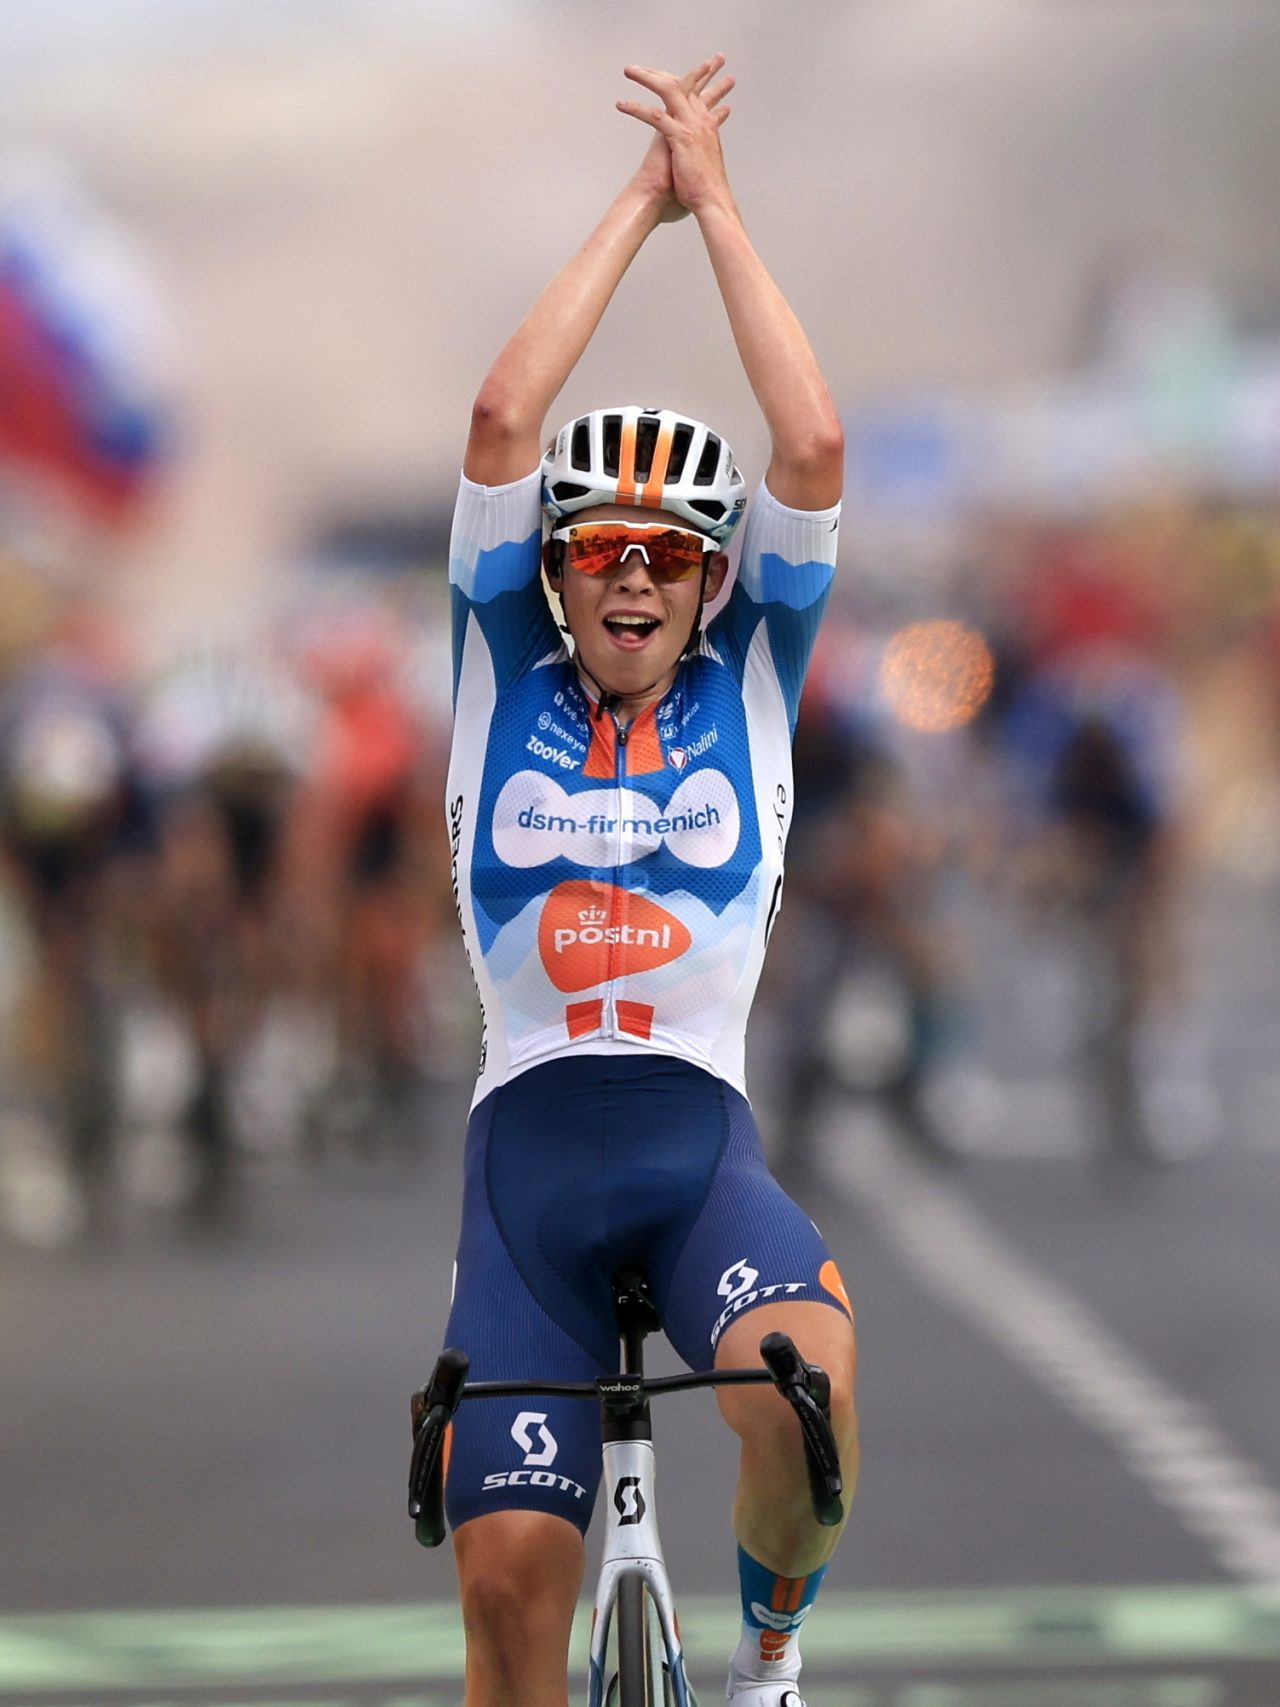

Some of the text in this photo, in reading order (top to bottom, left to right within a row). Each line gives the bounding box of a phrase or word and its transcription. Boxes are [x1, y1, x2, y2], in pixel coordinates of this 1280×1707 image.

[526, 735, 581, 771] zoover
[549, 721, 588, 753] nexeye
[686, 724, 719, 762] Nalini
[517, 802, 721, 835] dsm-firmenich
[554, 923, 672, 954] postnl
[710, 1282, 808, 1350] SCOTT
[600, 1382, 640, 1392] wahoo
[481, 1470, 587, 1499] SCOTT
